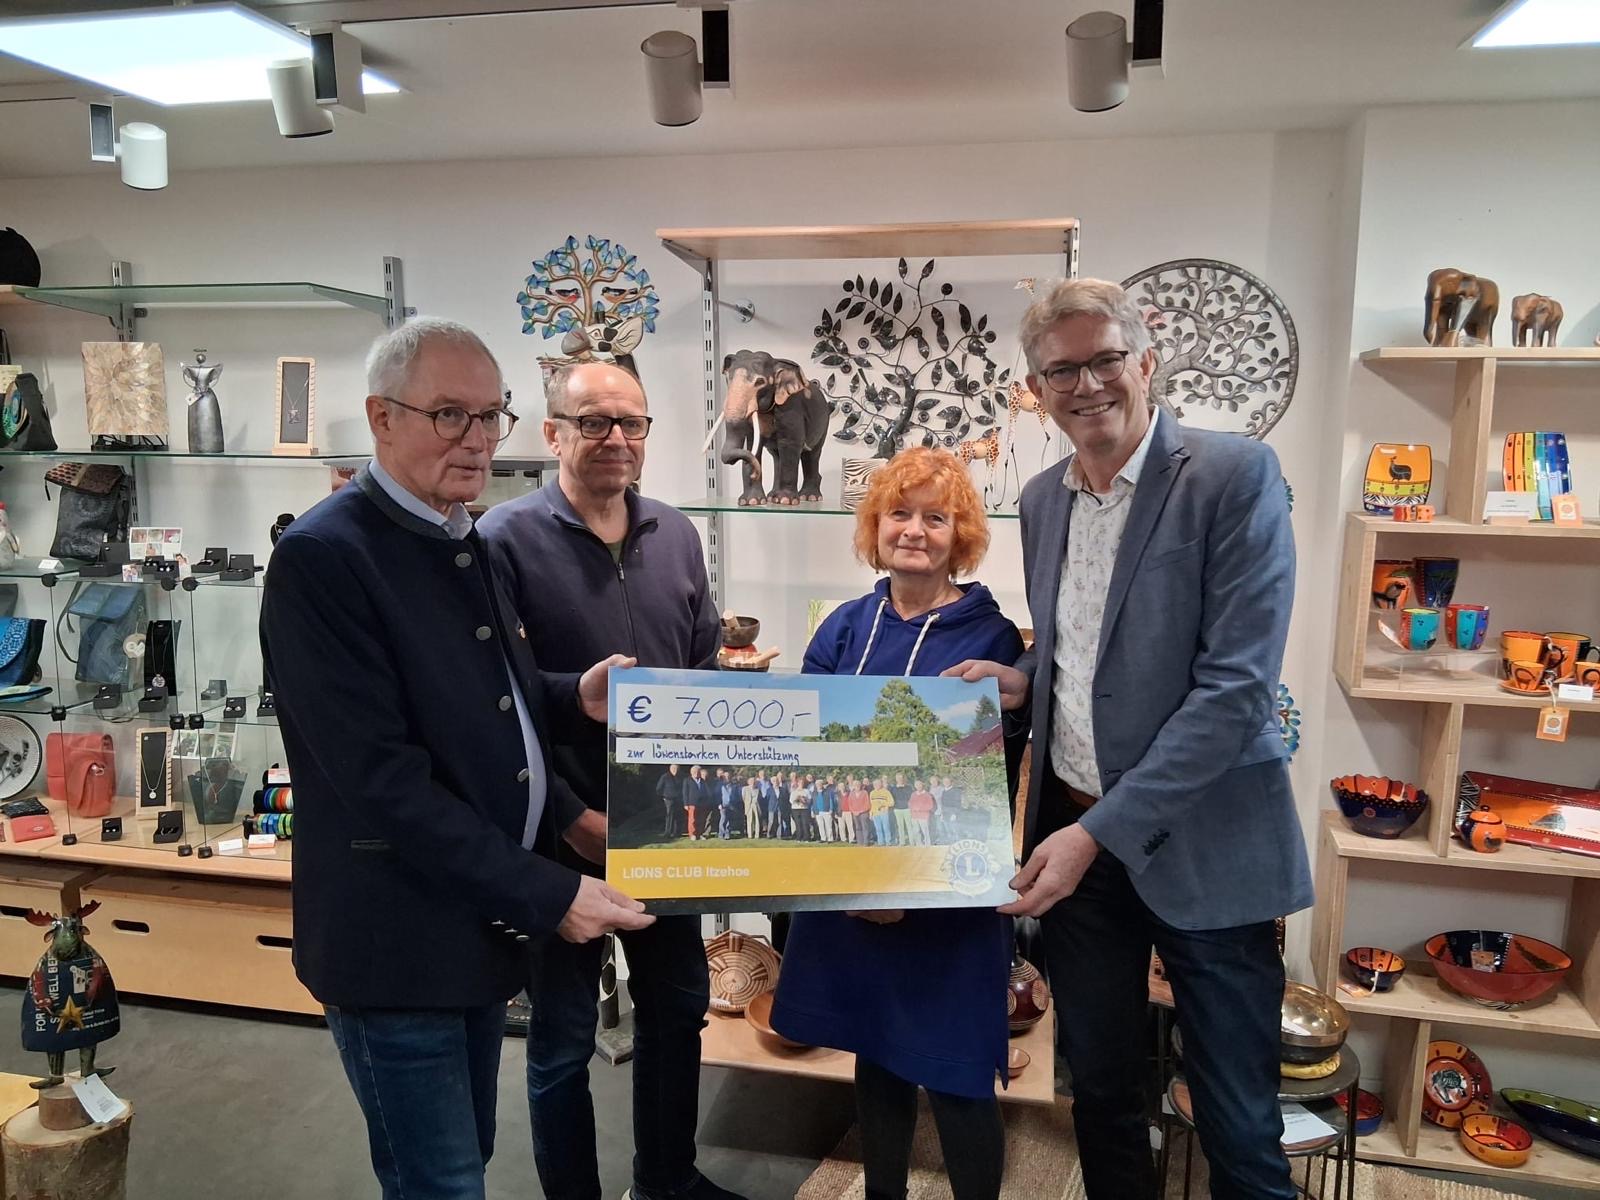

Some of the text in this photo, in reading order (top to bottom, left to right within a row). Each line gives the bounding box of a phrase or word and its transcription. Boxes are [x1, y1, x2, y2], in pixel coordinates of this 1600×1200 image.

[627, 695, 652, 723] €
[627, 743, 799, 767] zur löwenstarken Unterstützung
[952, 840, 986, 853] LIONS
[623, 866, 750, 879] LIONS CLUB Itzehoe
[47, 974, 59, 1000] WELL
[35, 1013, 46, 1032] FOR
